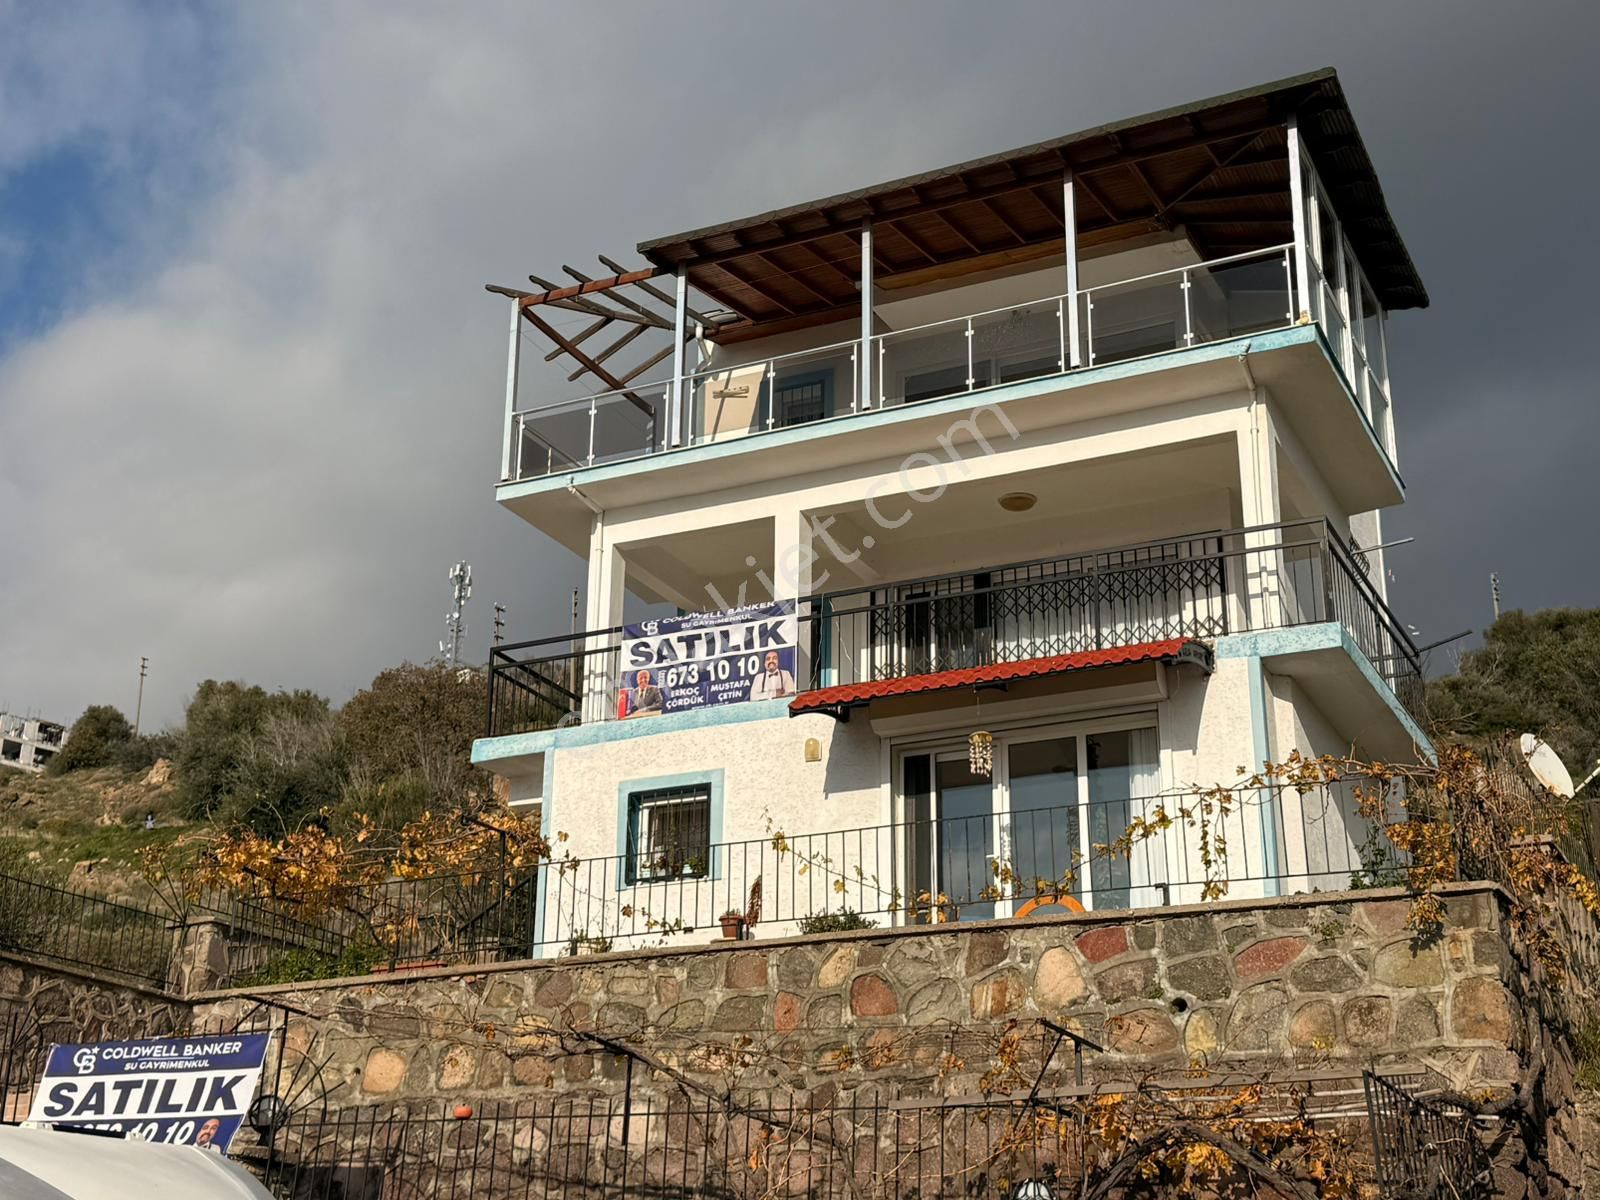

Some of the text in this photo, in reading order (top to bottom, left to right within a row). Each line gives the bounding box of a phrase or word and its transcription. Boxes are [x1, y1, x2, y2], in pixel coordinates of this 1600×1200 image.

[629, 619, 788, 668] SATILIK
[666, 663, 699, 688] 673
[706, 659, 730, 681] 10
[737, 655, 760, 677] 10
[670, 686, 700, 698] ERKOÇ
[710, 679, 751, 692] MUSTAFA
[717, 689, 743, 702] ÇETİN
[102, 1041, 242, 1060] COLDWELL BANKER
[124, 1062, 138, 1071] SU
[43, 1074, 247, 1118] SATILIK
[162, 1120, 196, 1146] 10
